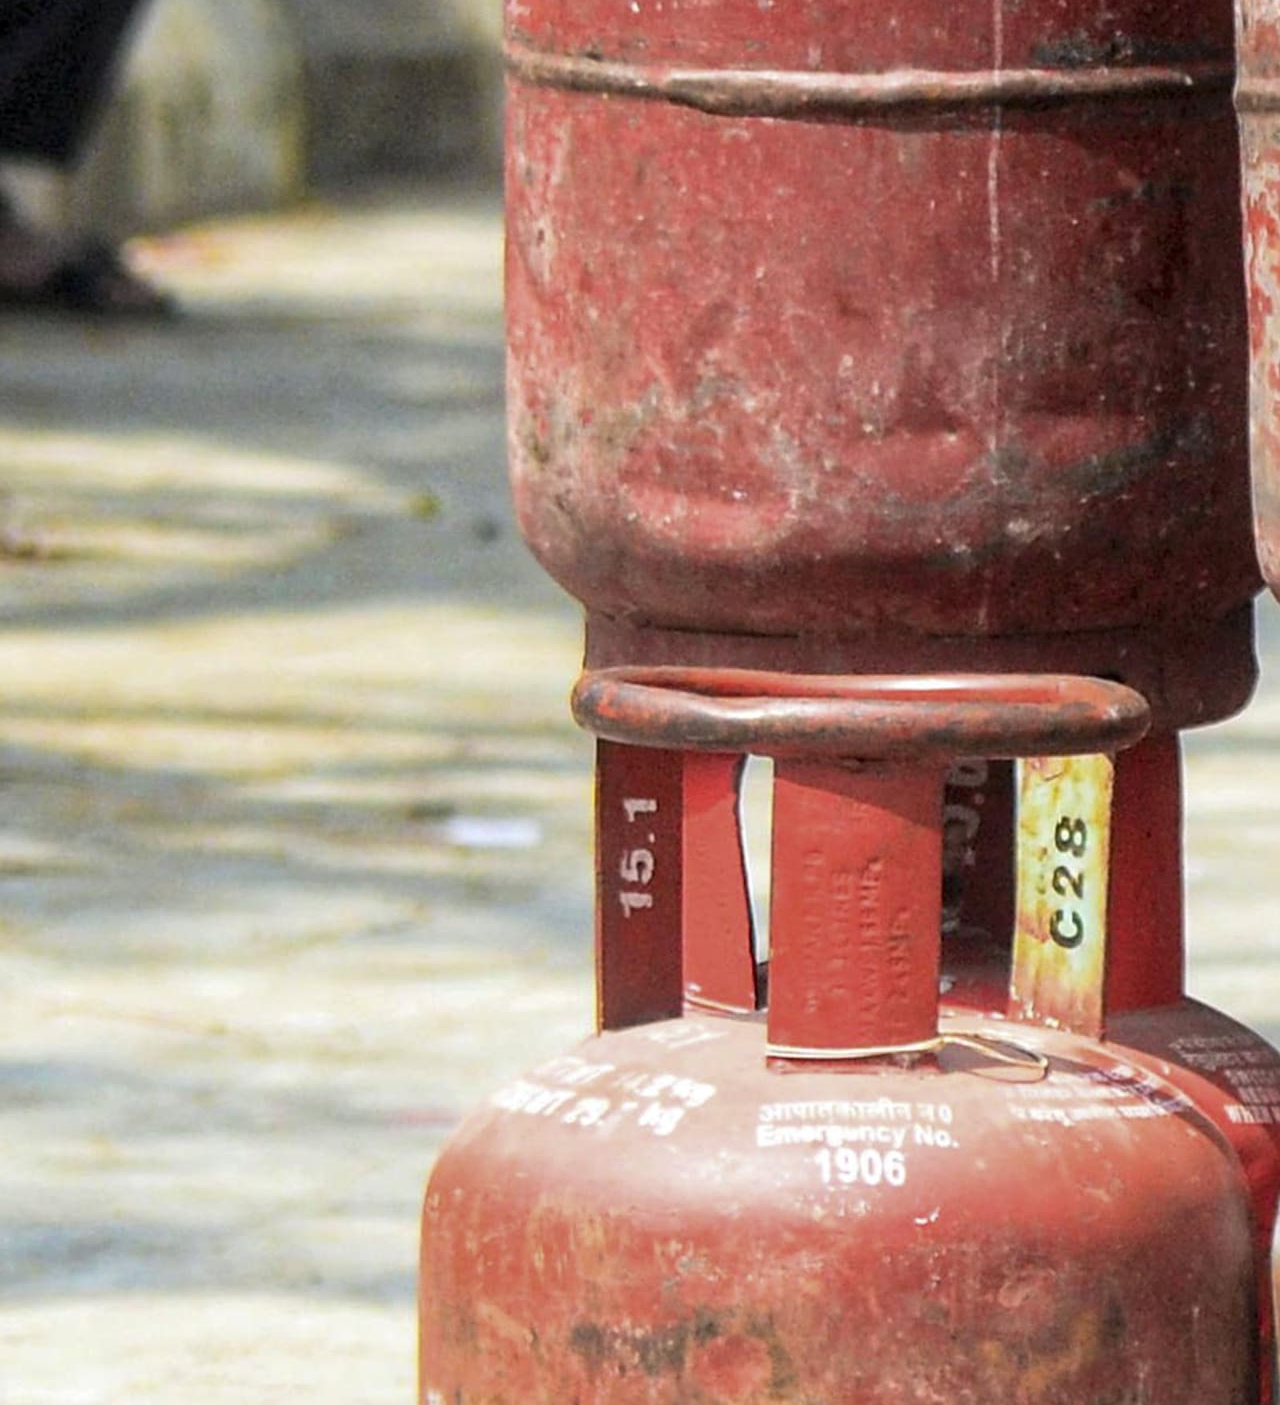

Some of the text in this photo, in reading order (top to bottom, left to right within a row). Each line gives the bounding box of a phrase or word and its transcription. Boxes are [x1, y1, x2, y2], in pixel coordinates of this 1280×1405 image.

[619, 798, 658, 918] 15.1
[756, 1124, 960, 1149] Emergency No.
[814, 1148, 907, 1186] 1906
